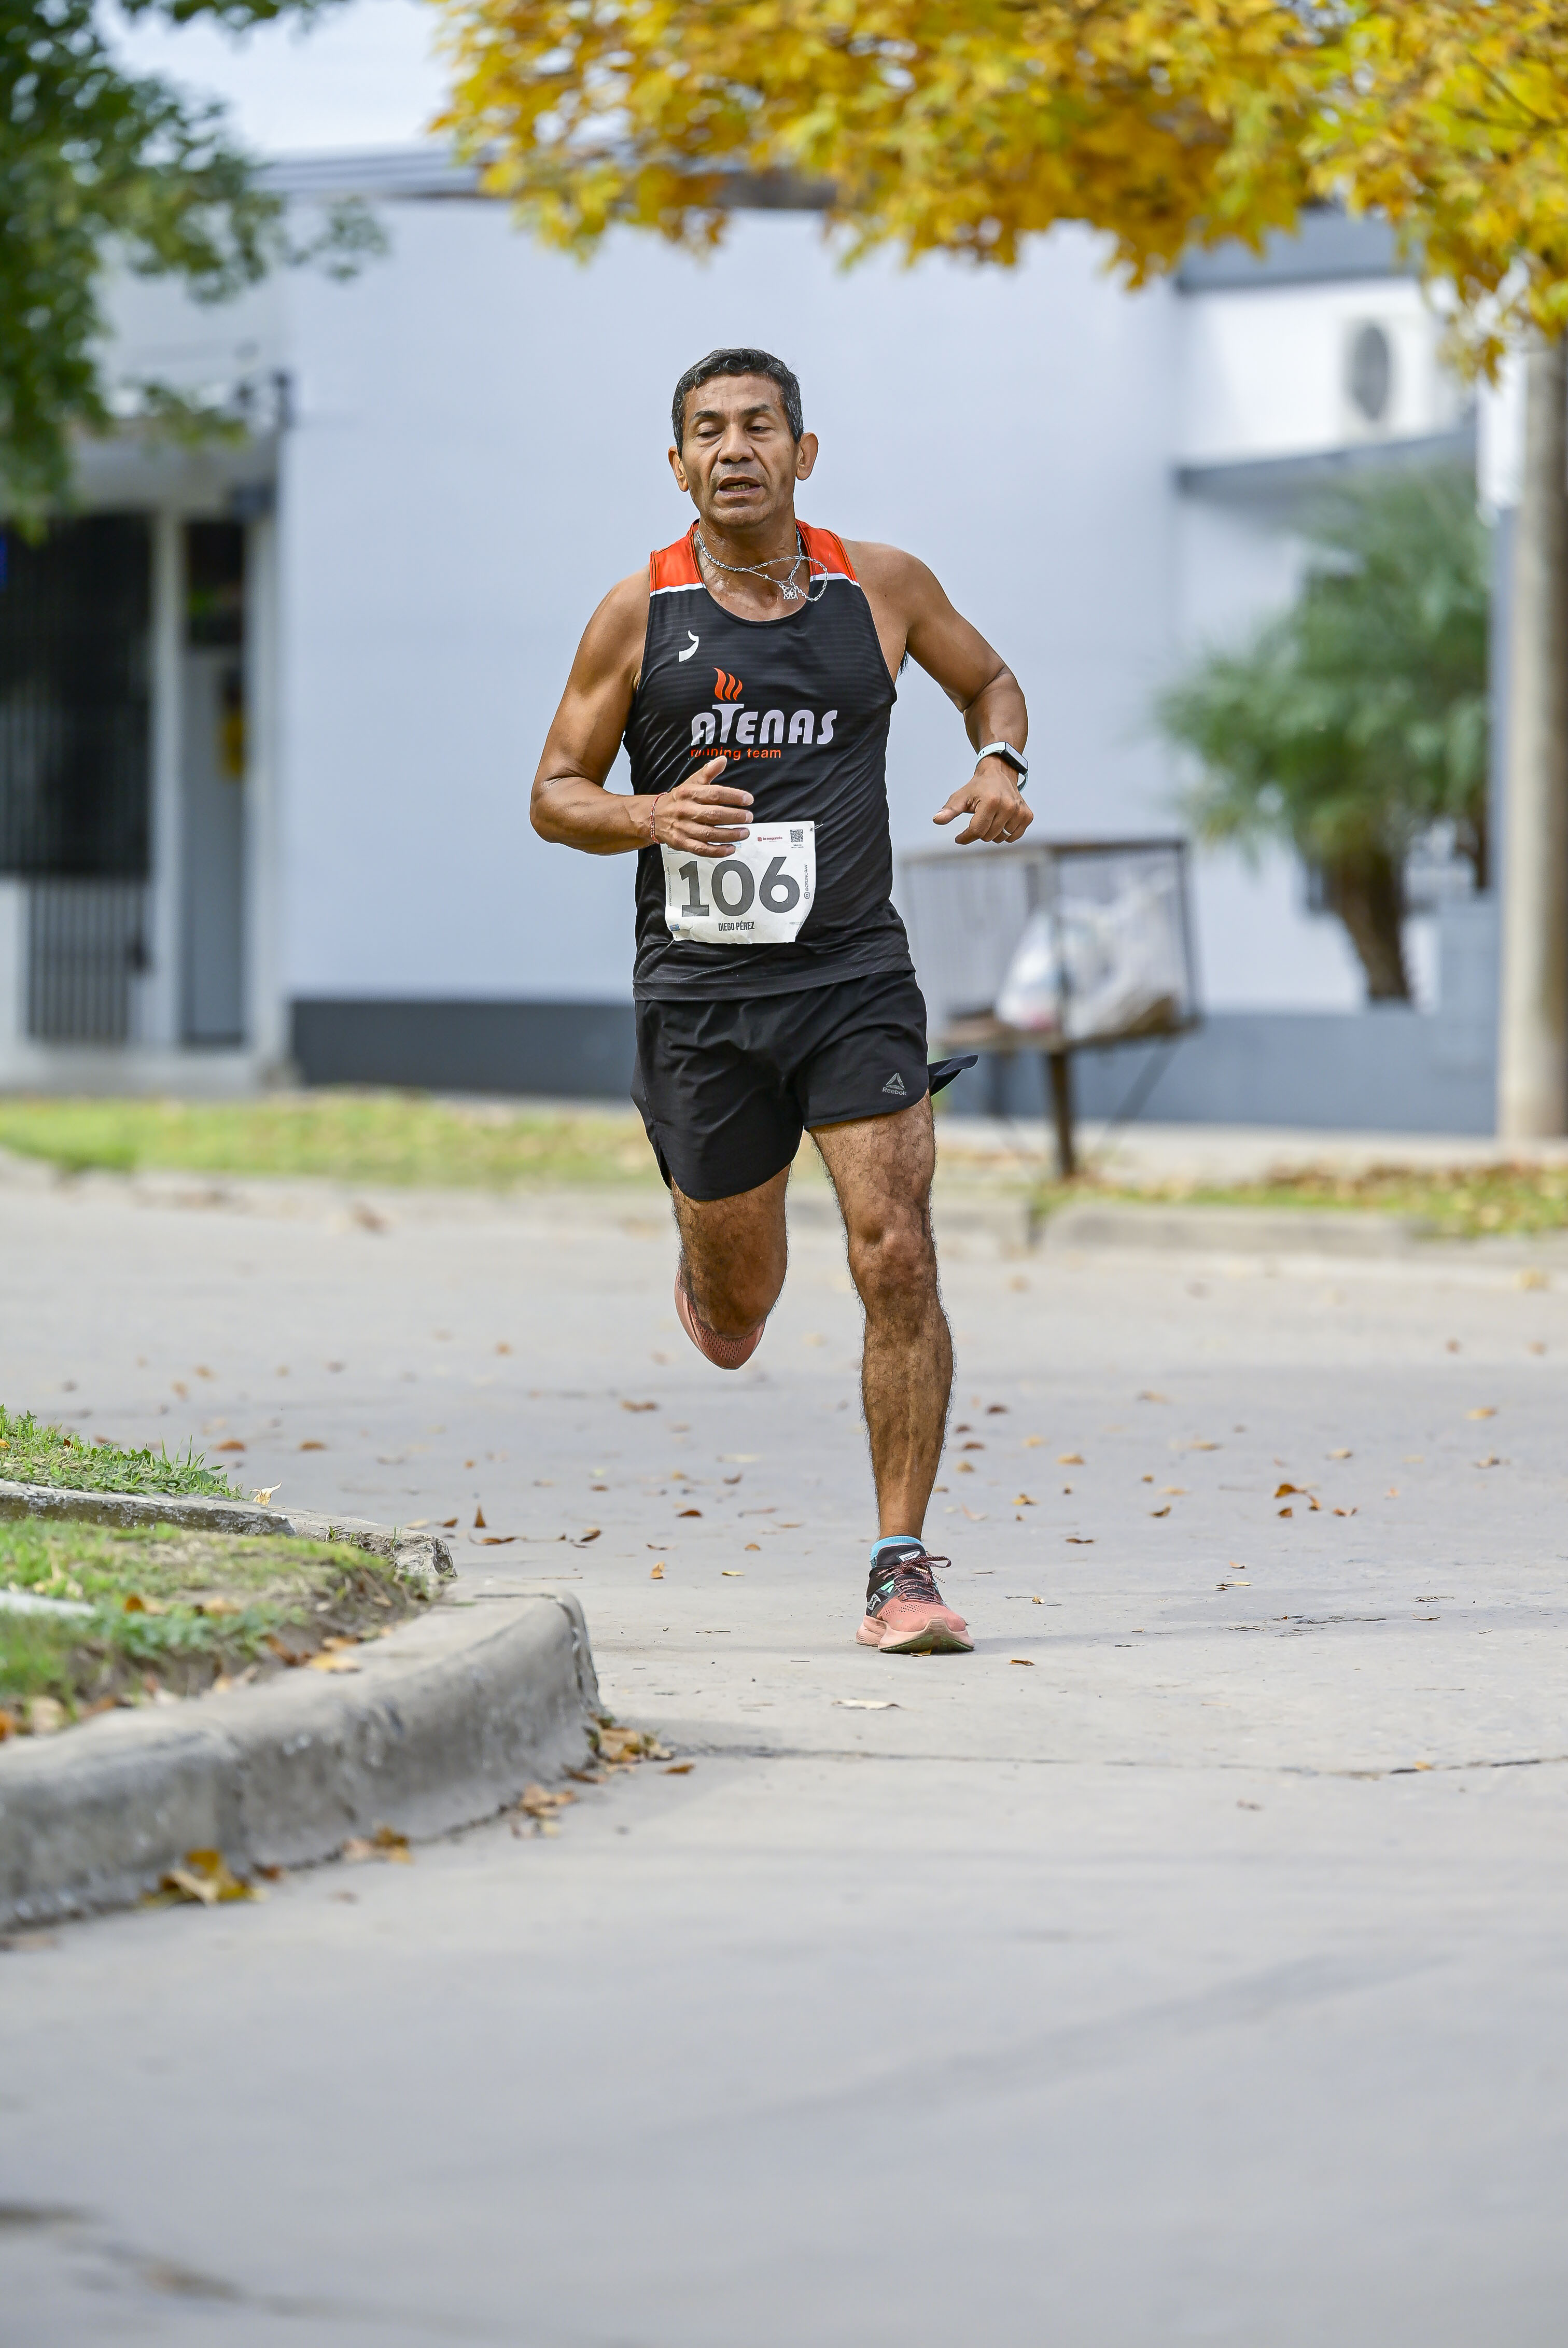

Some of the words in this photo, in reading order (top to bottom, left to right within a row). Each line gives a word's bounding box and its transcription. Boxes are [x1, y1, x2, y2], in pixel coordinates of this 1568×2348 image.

[747, 747, 781, 758] team
[678, 856, 800, 917] 106
[718, 923, 734, 931] DIEGO
[736, 920, 755, 930] PÉREZ
[883, 1087, 907, 1096] Reebok
